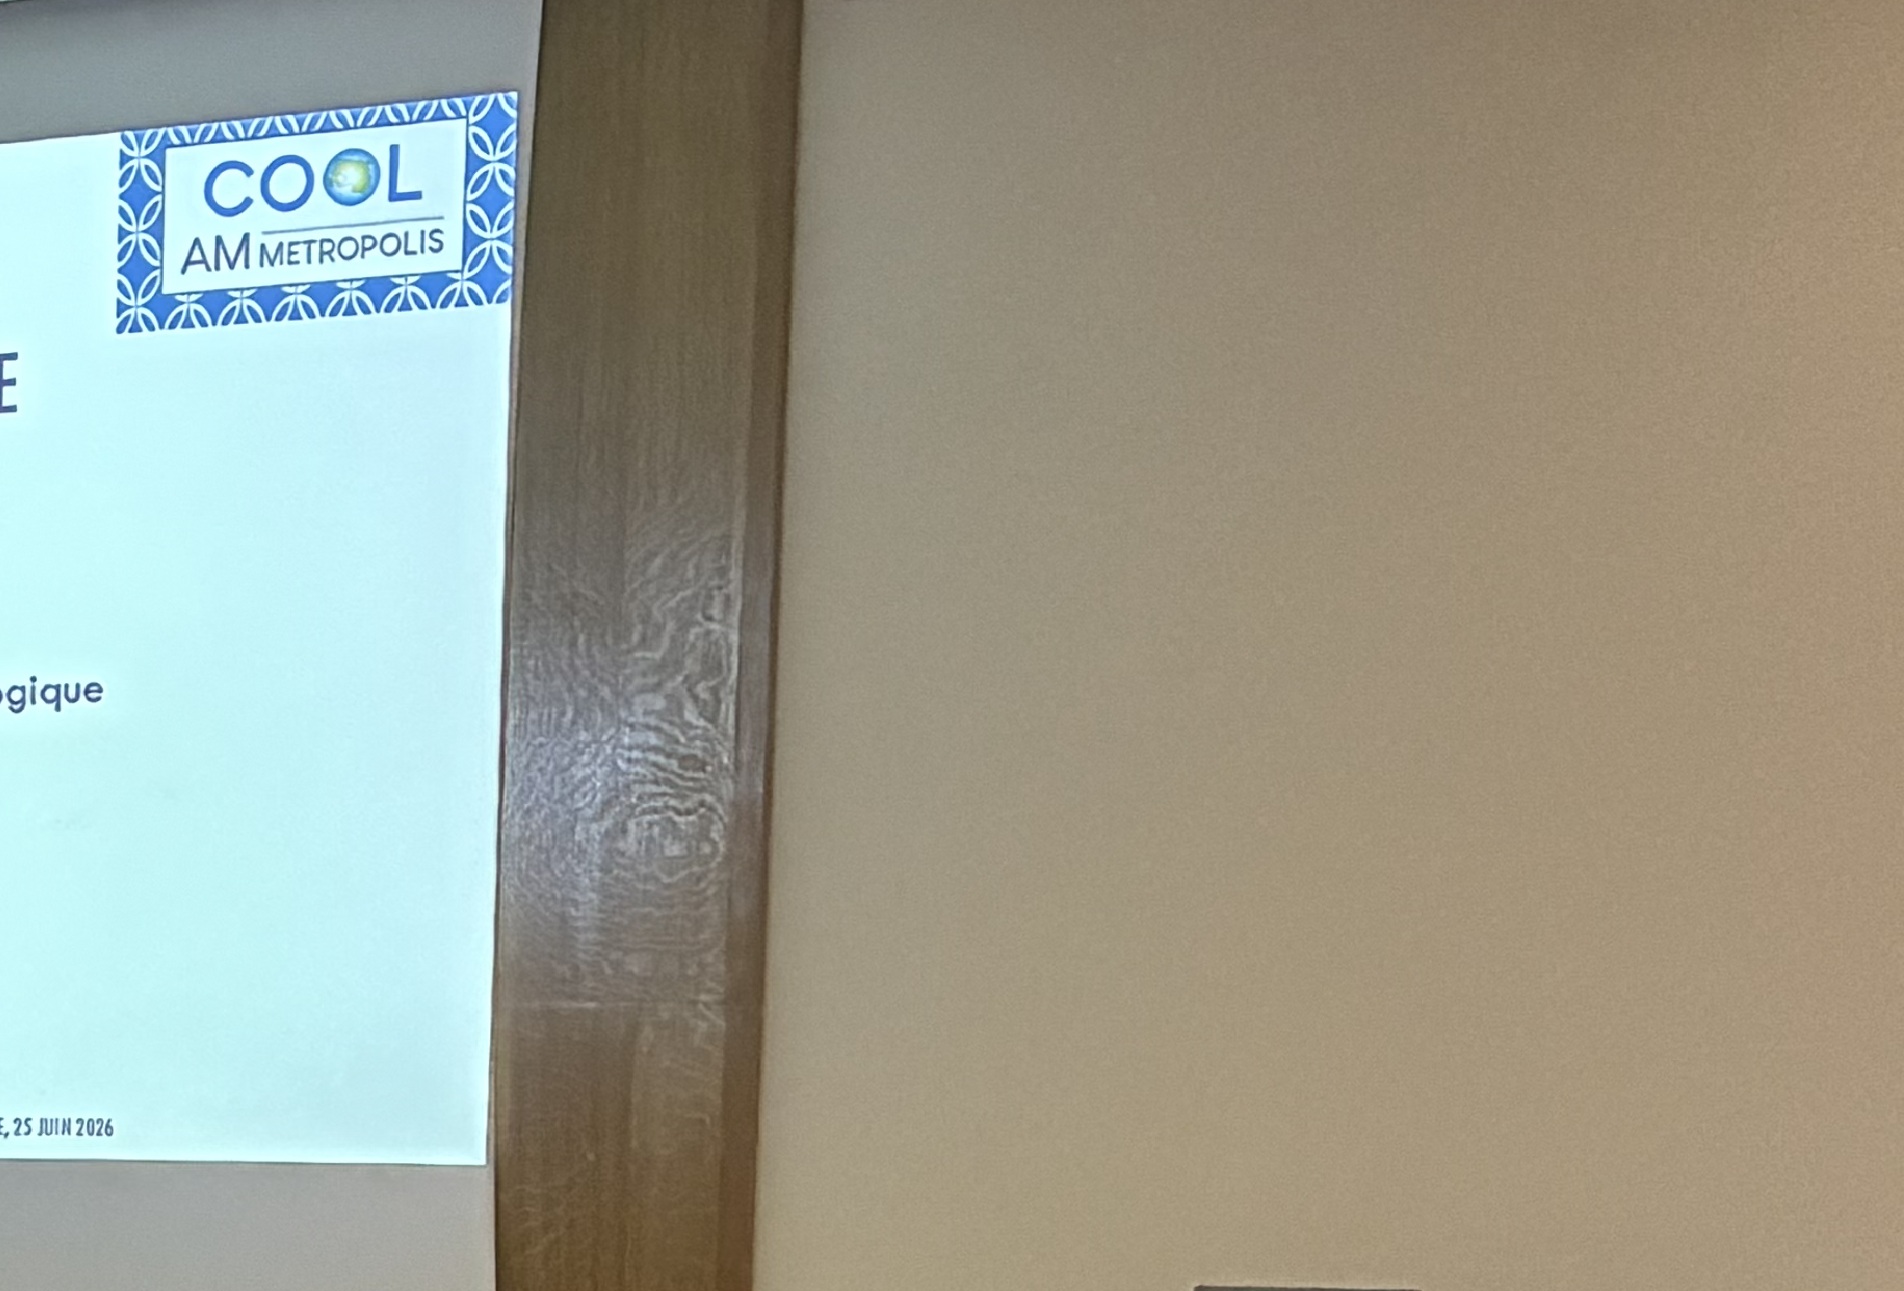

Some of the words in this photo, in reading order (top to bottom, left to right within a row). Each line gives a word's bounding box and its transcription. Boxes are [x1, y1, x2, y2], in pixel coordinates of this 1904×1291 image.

[203, 143, 422, 218] COOL
[181, 231, 251, 276] AM
[258, 227, 445, 269] METROPOLIS
[13, 1117, 33, 1136] 25
[37, 1117, 73, 1136] JUIN
[75, 1118, 114, 1137] 2026
